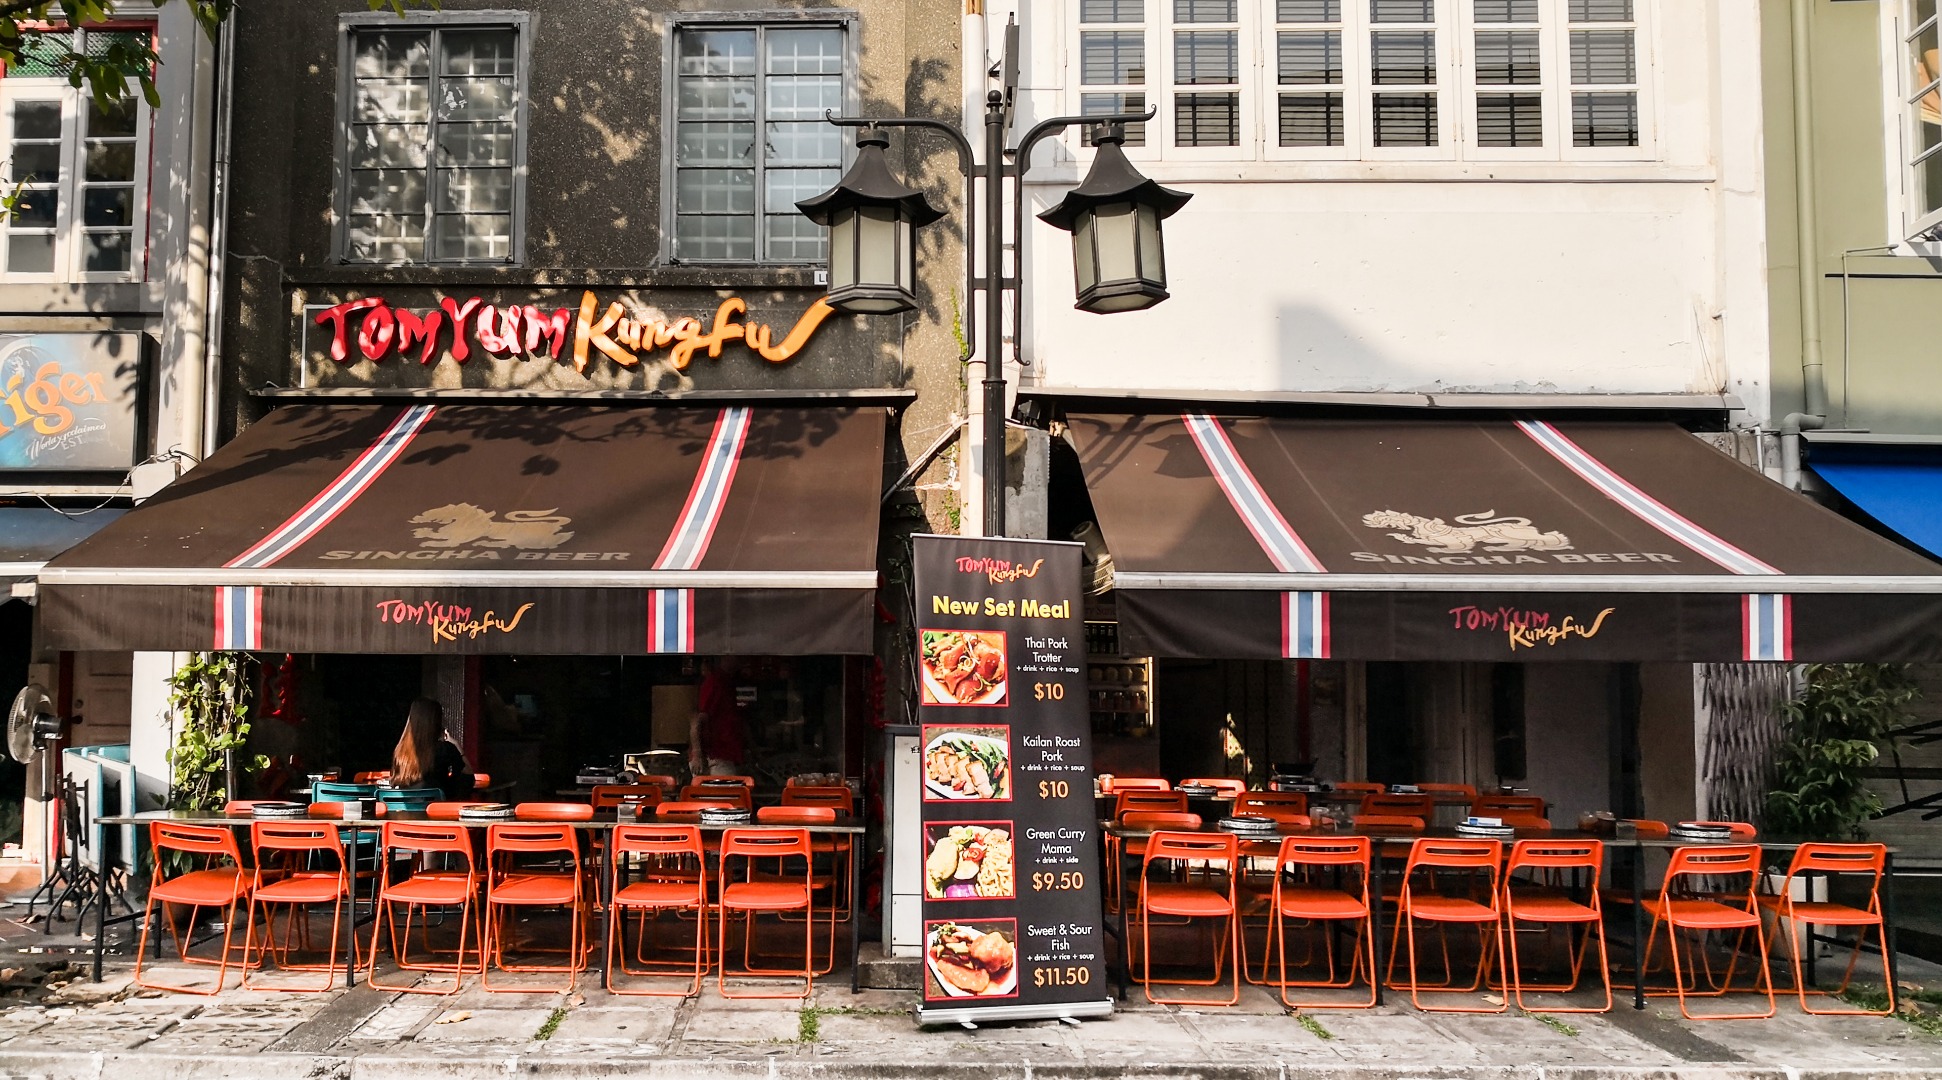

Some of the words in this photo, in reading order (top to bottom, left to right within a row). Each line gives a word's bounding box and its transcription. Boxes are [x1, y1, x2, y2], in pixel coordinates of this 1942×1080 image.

[317, 549, 502, 562] SINGHA
[514, 551, 632, 562] BEER
[1350, 551, 1549, 566] SINGHA
[1552, 552, 1682, 564] BEER
[932, 595, 980, 616] New
[984, 597, 1016, 617] Set
[1020, 598, 1070, 619] Meal
[1025, 637, 1046, 649] Thai
[1048, 638, 1069, 650] Pork
[1032, 651, 1062, 663] Trotter
[1023, 664, 1038, 672] drink
[1065, 666, 1079, 674] soup
[1034, 681, 1064, 702] $10
[1023, 735, 1053, 748] Kailan
[1055, 737, 1081, 749] Roast
[1041, 750, 1063, 763] Pork
[1027, 763, 1042, 771] drink
[1070, 764, 1085, 773] soup
[1038, 779, 1069, 800] $10
[1026, 828, 1056, 841] Green
[1058, 828, 1086, 843] Curry
[1041, 843, 1072, 855] Mama
[1042, 856, 1057, 864] drink
[1066, 855, 1079, 864] side
[1032, 871, 1084, 892] $9.50
[1027, 924, 1057, 937] Sweet
[1059, 924, 1068, 936] &
[1069, 923, 1093, 936] Sour
[1051, 938, 1070, 951] Fish
[1034, 953, 1051, 961] drink
[1079, 952, 1095, 962] soup
[1034, 966, 1090, 988] $11.50
